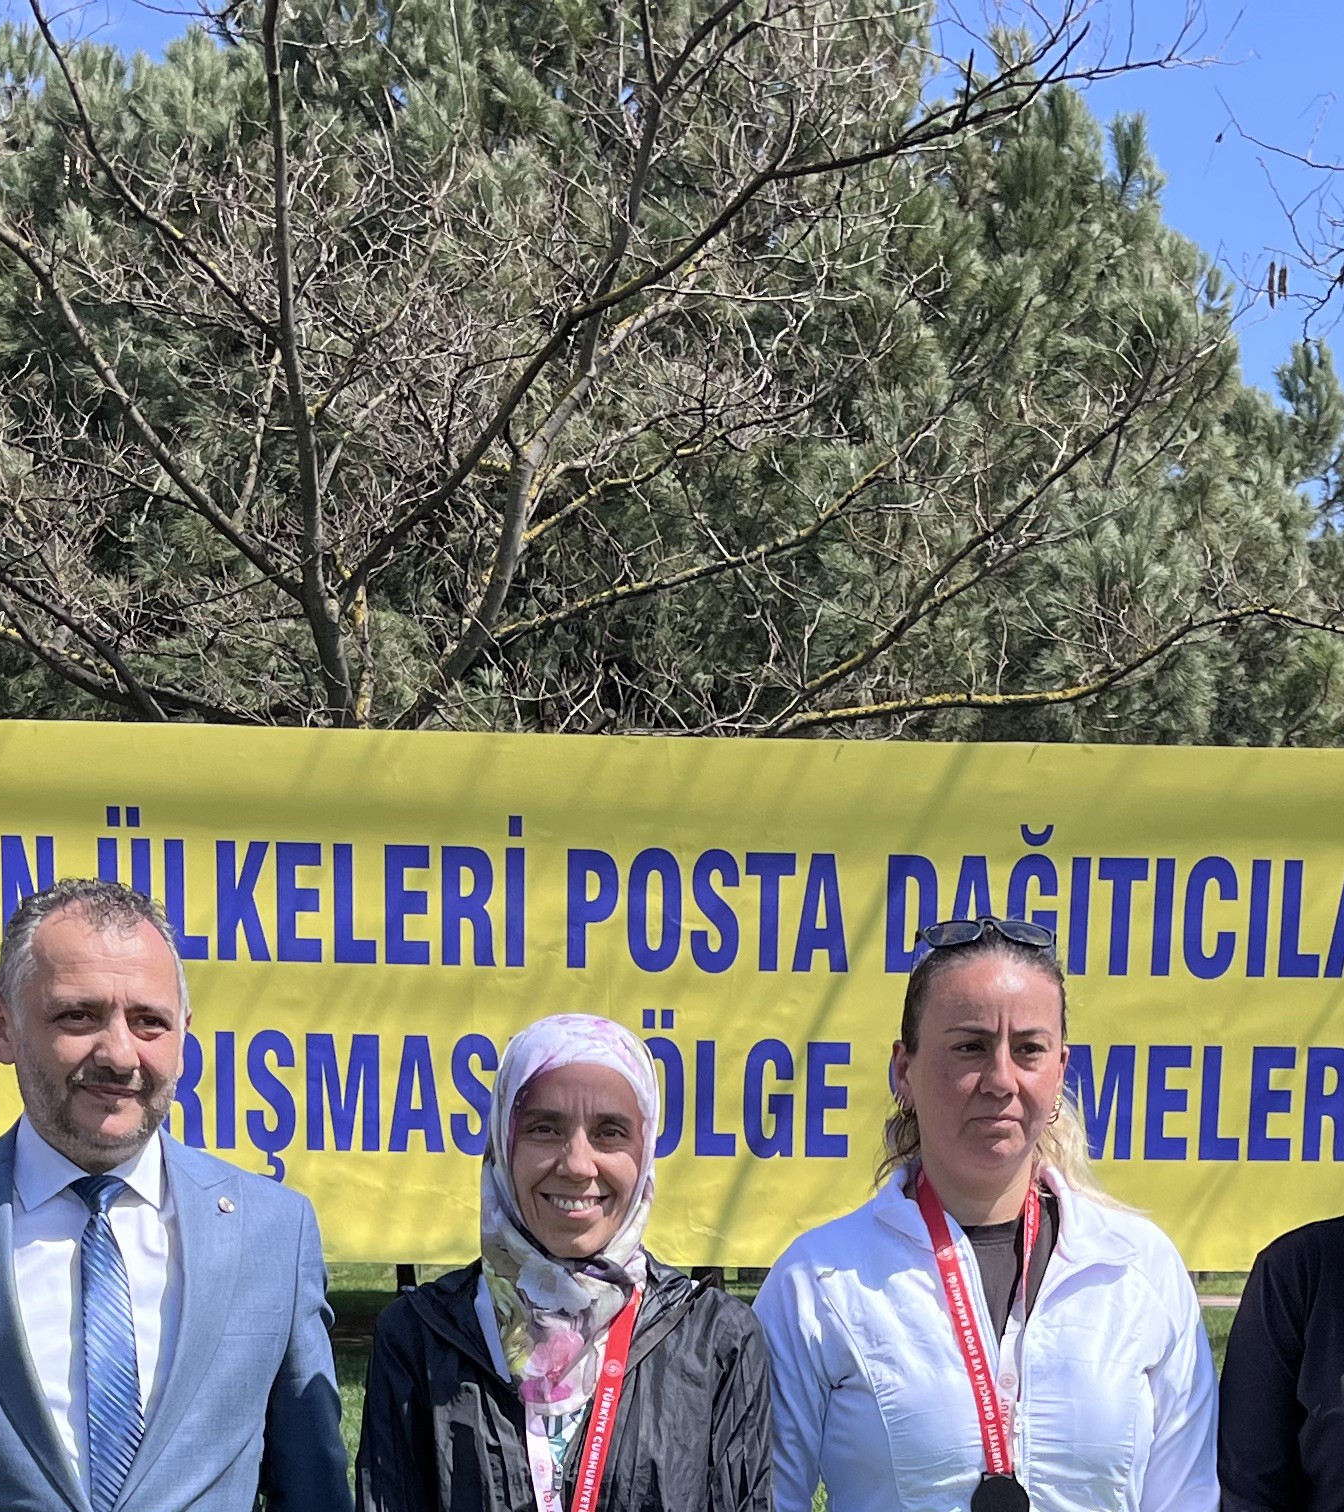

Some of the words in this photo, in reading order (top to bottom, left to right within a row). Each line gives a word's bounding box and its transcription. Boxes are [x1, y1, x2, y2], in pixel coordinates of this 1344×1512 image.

[97, 805, 526, 967] ÜLKELERİ
[566, 847, 849, 974] POSTA
[160, 1029, 514, 1183] RIŞMAS
[642, 1008, 851, 1159] ÖLGE
[945, 1270, 970, 1328] BAKANLIĞI
[962, 1327, 979, 1357] SPOR
[969, 1356, 983, 1372] VE
[594, 1386, 615, 1434] TÜRKİYE
[972, 1372, 995, 1422] GENÇLİK
[983, 1422, 1005, 1474] HURİYETİ
